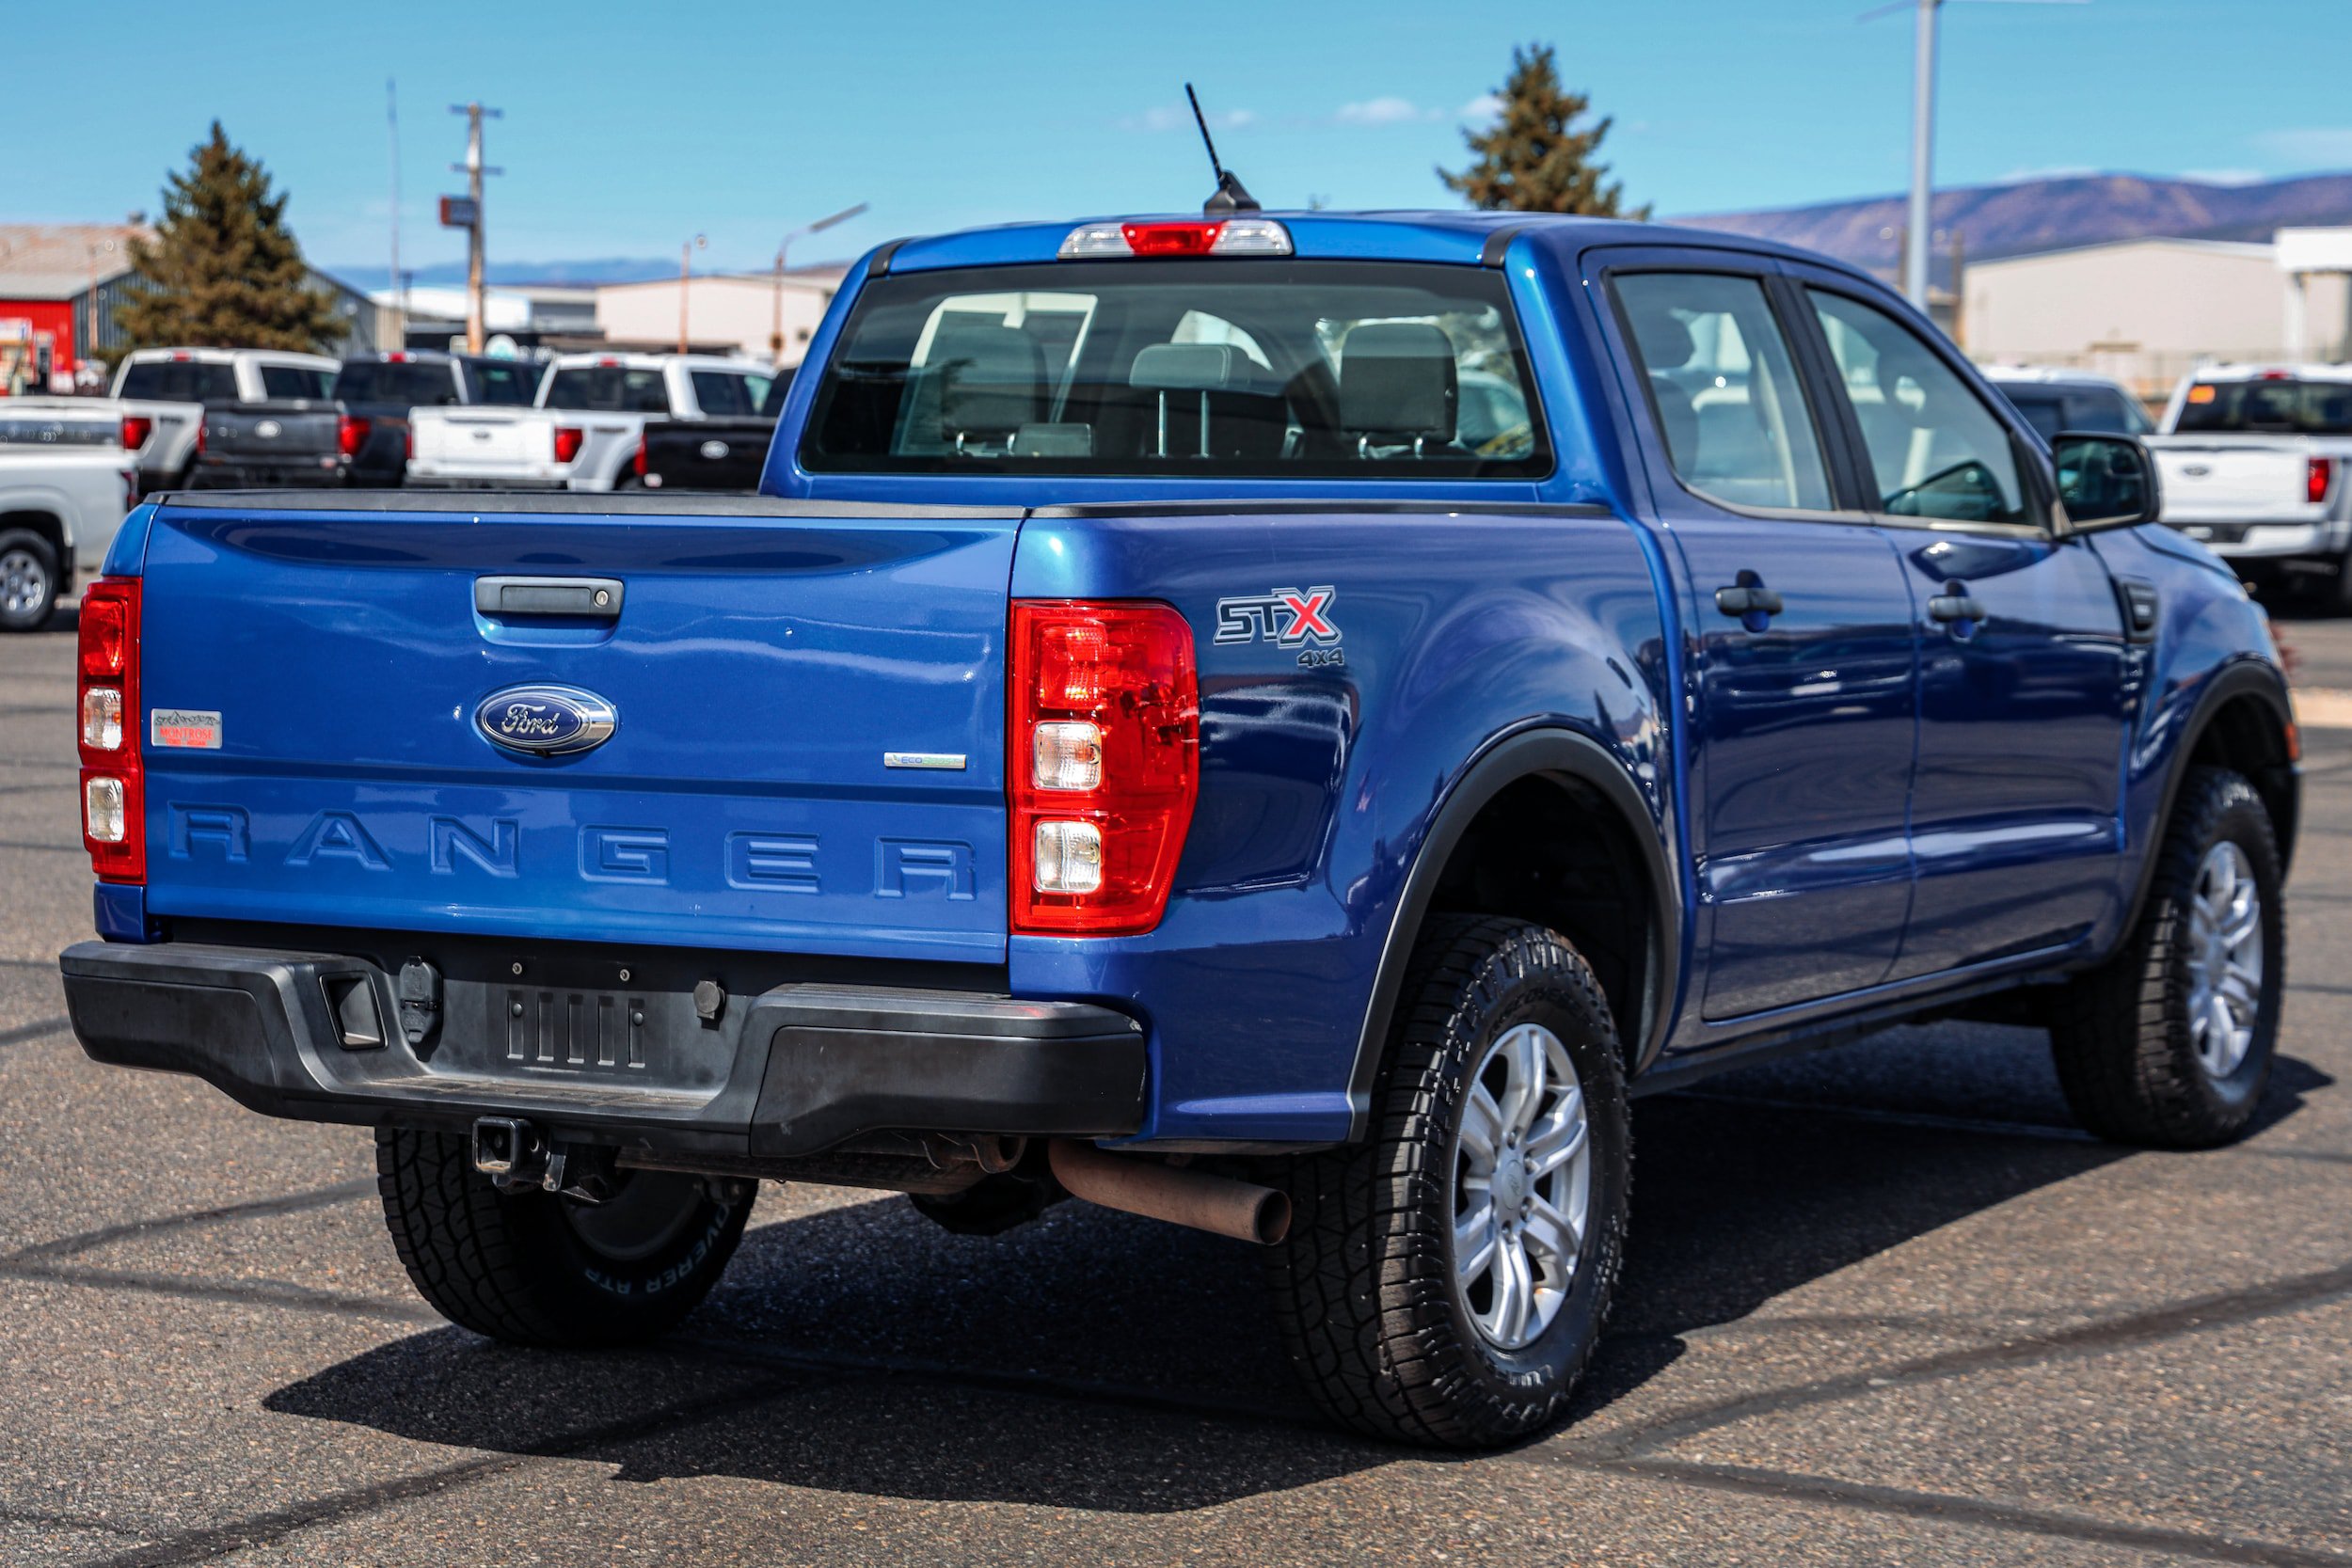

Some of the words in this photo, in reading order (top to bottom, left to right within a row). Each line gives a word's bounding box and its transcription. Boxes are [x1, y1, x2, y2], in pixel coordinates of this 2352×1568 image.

[1214, 585, 1343, 649] STX
[159, 726, 214, 740] MONTROSE
[501, 703, 561, 735] Ford
[167, 800, 975, 901] RANGER
